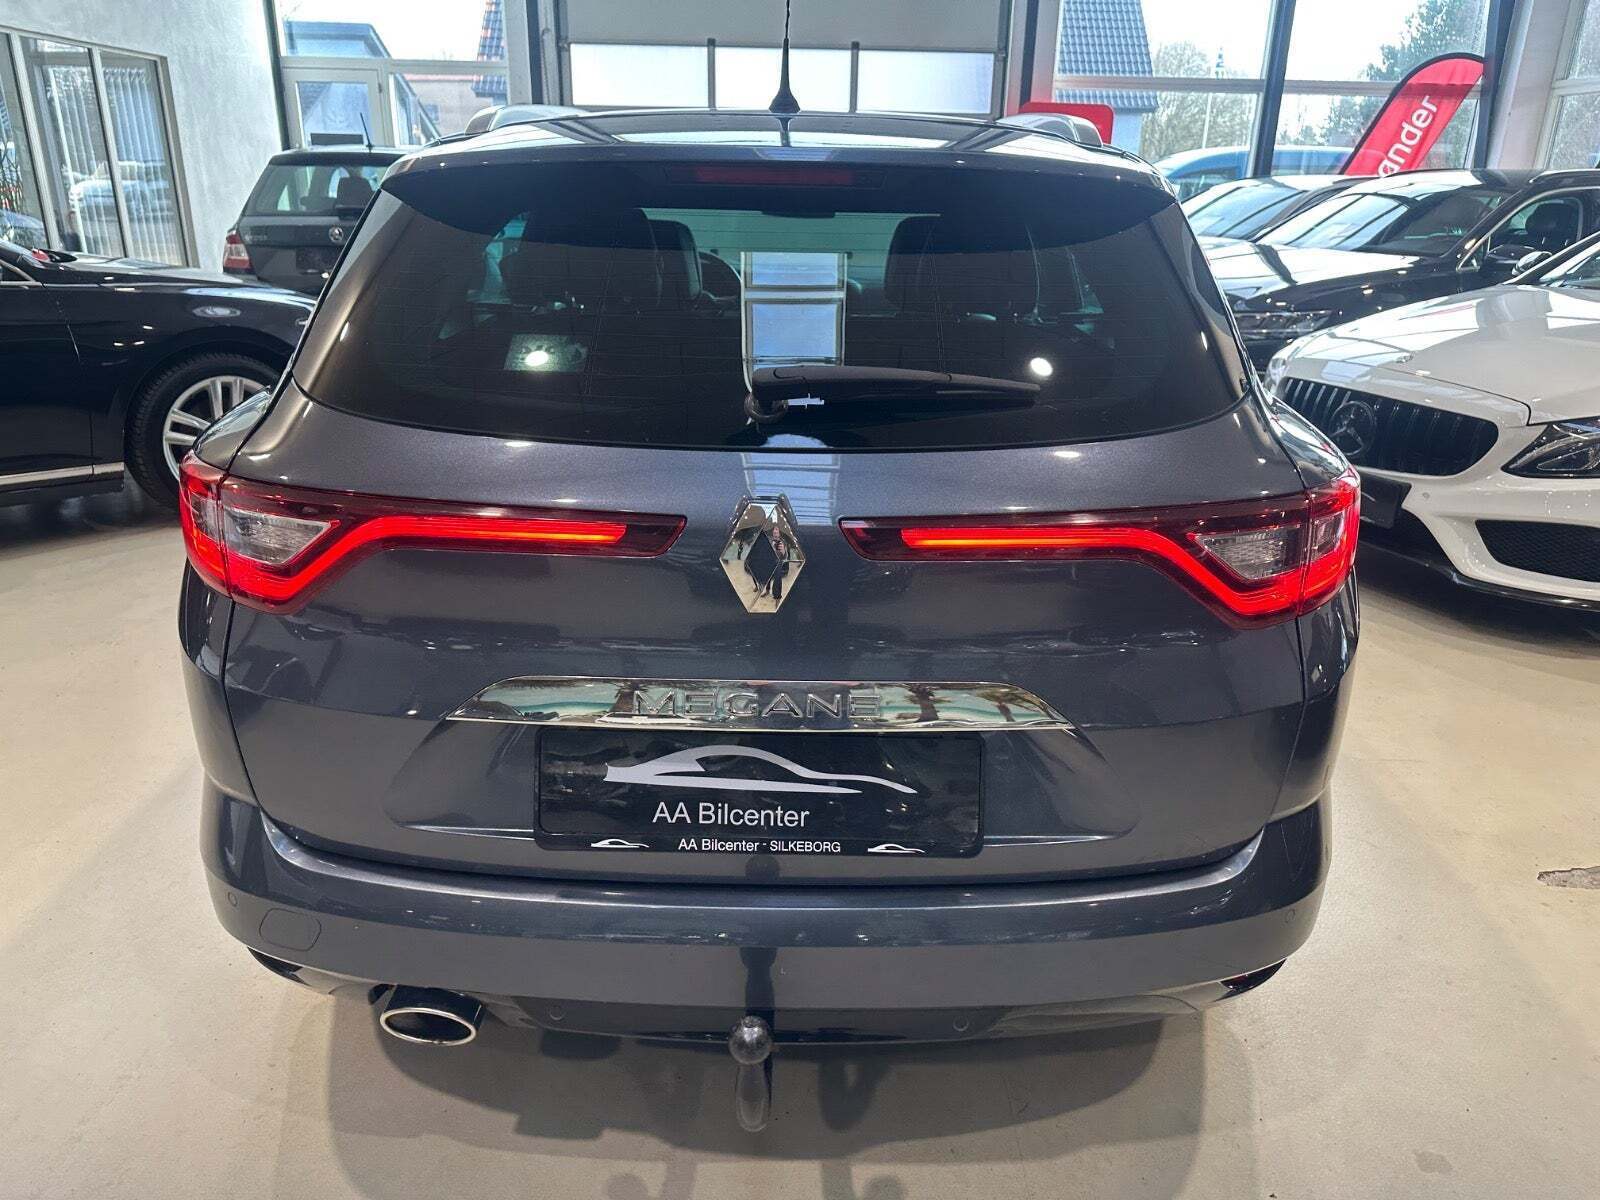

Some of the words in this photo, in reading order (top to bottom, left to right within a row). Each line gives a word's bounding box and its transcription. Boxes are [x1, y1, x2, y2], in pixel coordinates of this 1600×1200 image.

[633, 690, 881, 718] MEGANE
[652, 801, 692, 824] AA
[698, 802, 810, 828] Bilcenter
[678, 838, 698, 851] AA
[701, 838, 759, 852] Bilcenter
[769, 841, 841, 853] SILKEBORG
